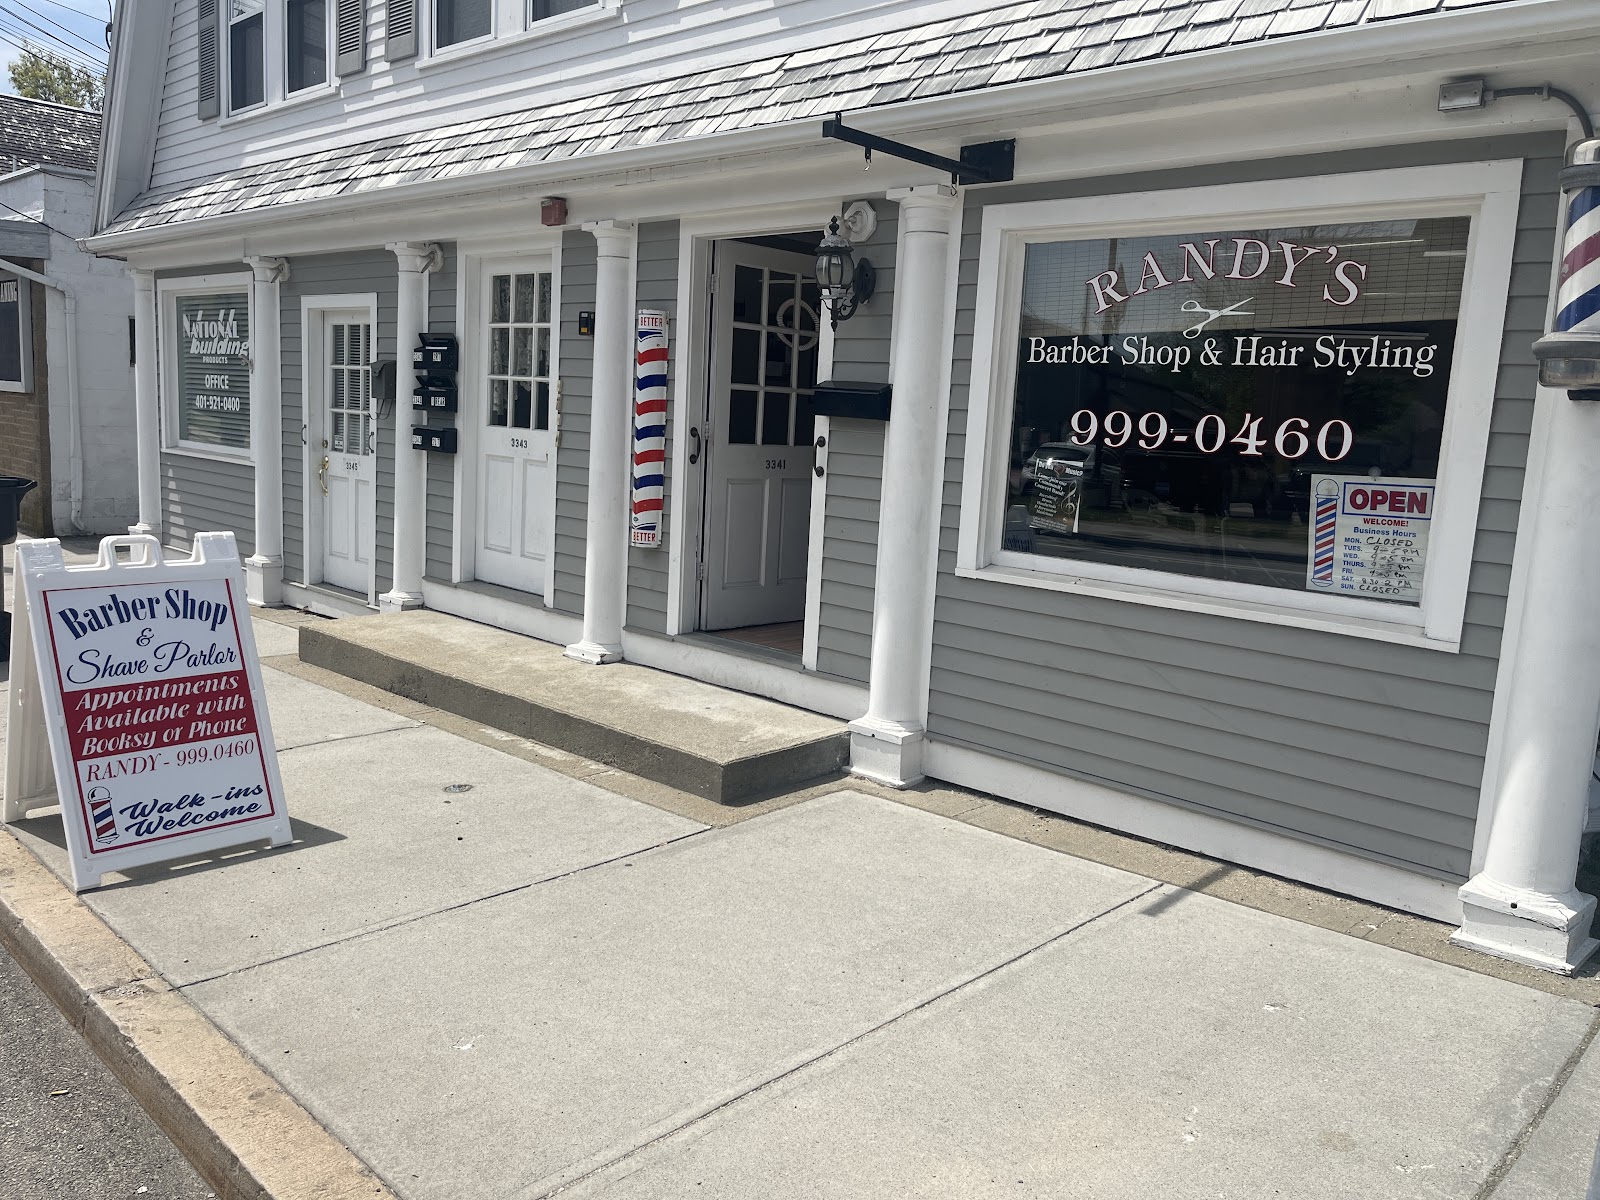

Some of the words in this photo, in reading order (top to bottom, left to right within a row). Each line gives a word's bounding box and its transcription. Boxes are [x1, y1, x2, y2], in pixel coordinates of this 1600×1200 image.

[1085, 237, 1368, 315] RANDY'S
[640, 316, 663, 328] BETTER
[190, 337, 250, 357] building
[1027, 336, 1114, 365] Barber
[1121, 336, 1191, 372] Shop
[1199, 338, 1223, 366] &
[1231, 336, 1304, 367] Hair
[1313, 335, 1438, 377] Styling
[203, 356, 228, 364] PRODUCTS
[205, 375, 229, 389] OFFICE
[196, 395, 240, 411] 401-921-0400
[511, 438, 528, 449] 3343
[1070, 409, 1354, 461] 999-0460
[346, 462, 358, 471] 3345
[765, 459, 786, 470] 3341
[1349, 489, 1428, 514] OPEN
[1353, 527, 1390, 536] Business
[1393, 530, 1417, 538] Hours
[1363, 518, 1409, 527] WELCOME!
[633, 532, 656, 542] BETTER
[1366, 537, 1413, 547] CLOSED
[1359, 585, 1400, 594] CLOSED
[56, 593, 160, 640] Barber
[164, 588, 228, 632] Shop
[136, 627, 154, 647] &
[67, 649, 149, 684] Shave
[154, 640, 237, 672] Parlor
[75, 675, 239, 711] Appointments
[77, 700, 189, 734] Available
[197, 693, 246, 717] with
[81, 729, 157, 757] Booksy
[163, 725, 184, 743] or
[189, 717, 247, 738] Phone
[177, 739, 255, 767] 999.0460
[124, 800, 262, 838] Welcome
